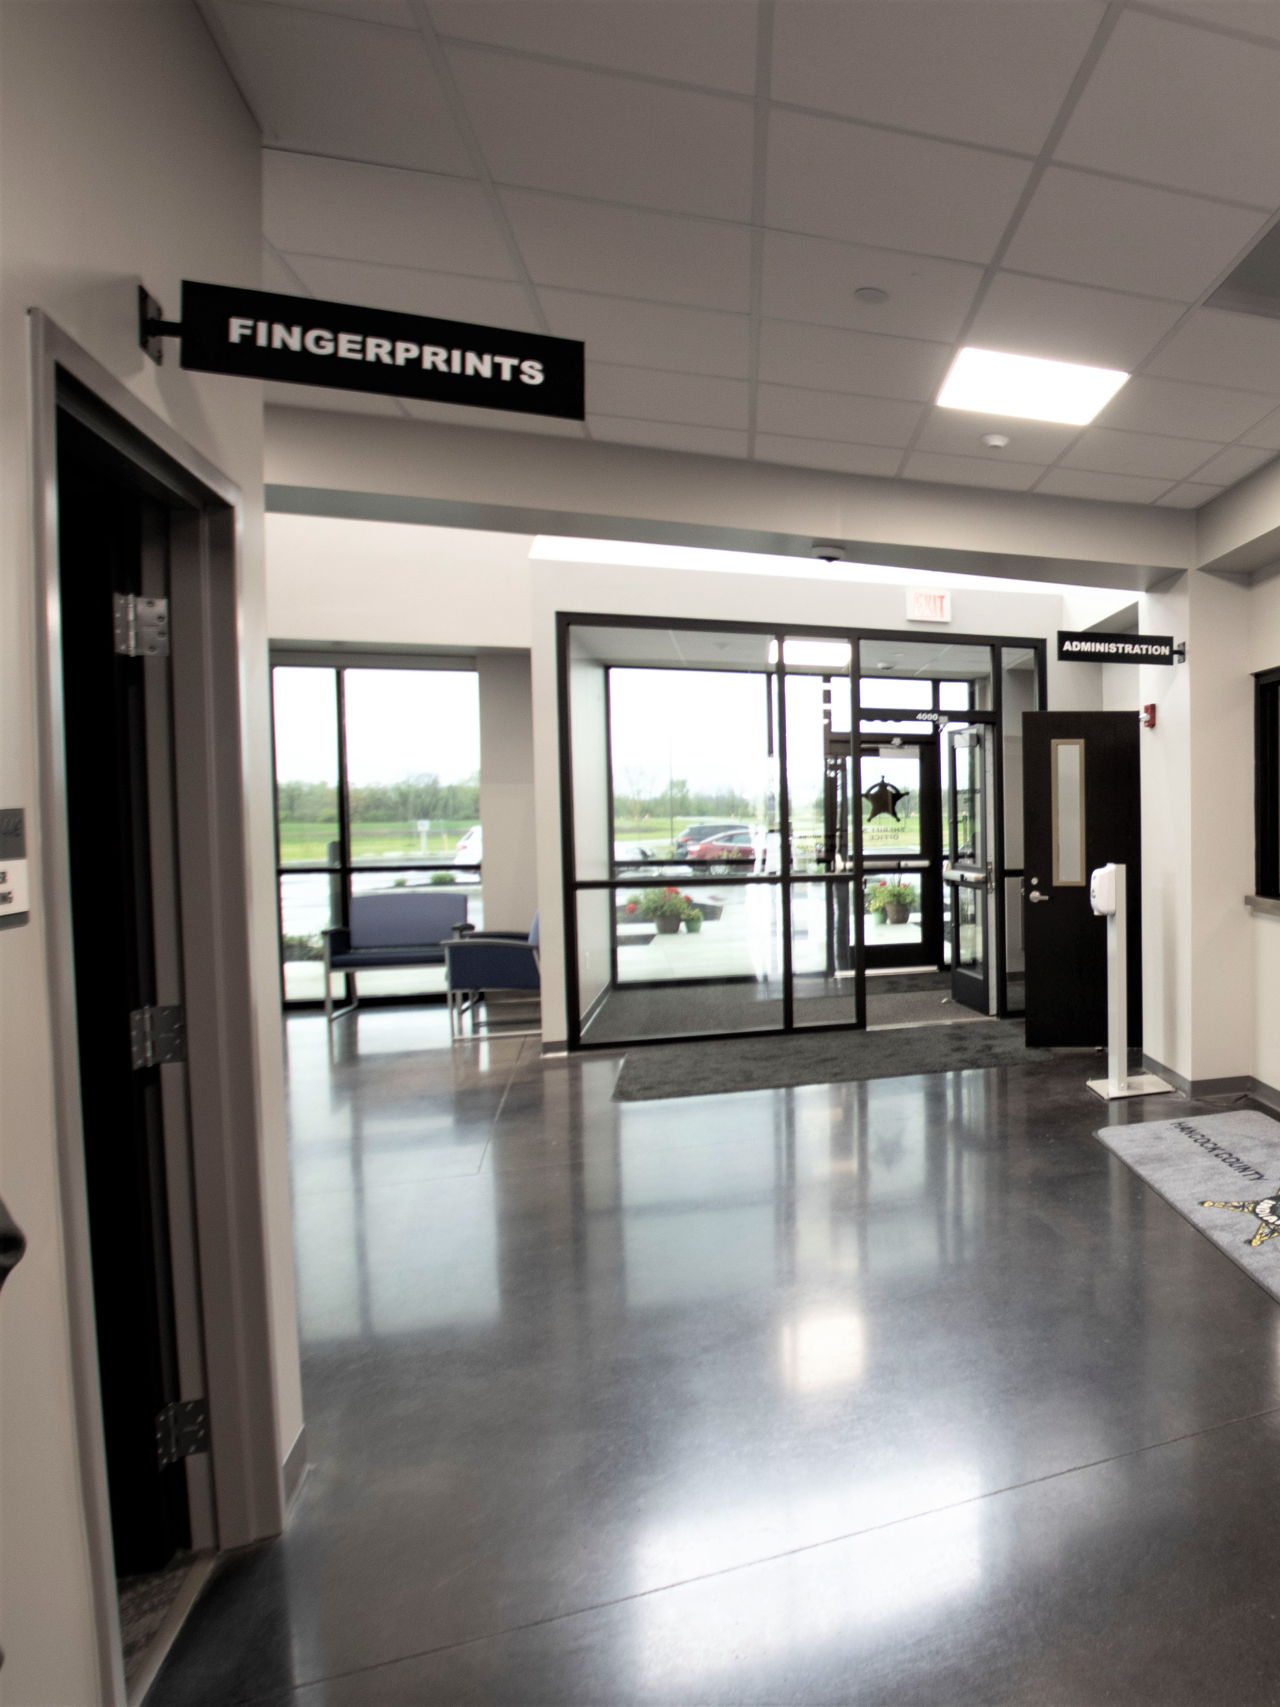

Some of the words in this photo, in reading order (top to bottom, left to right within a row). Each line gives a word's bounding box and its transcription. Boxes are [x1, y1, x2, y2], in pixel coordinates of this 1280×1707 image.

[228, 316, 545, 386] FINGERPRINTS
[912, 592, 945, 618] EXIT
[1062, 640, 1170, 656] ADMINISTRATION
[915, 712, 939, 722] 4000
[1170, 1121, 1226, 1153] HANCOCK
[1214, 1152, 1268, 1181] COUNTY
